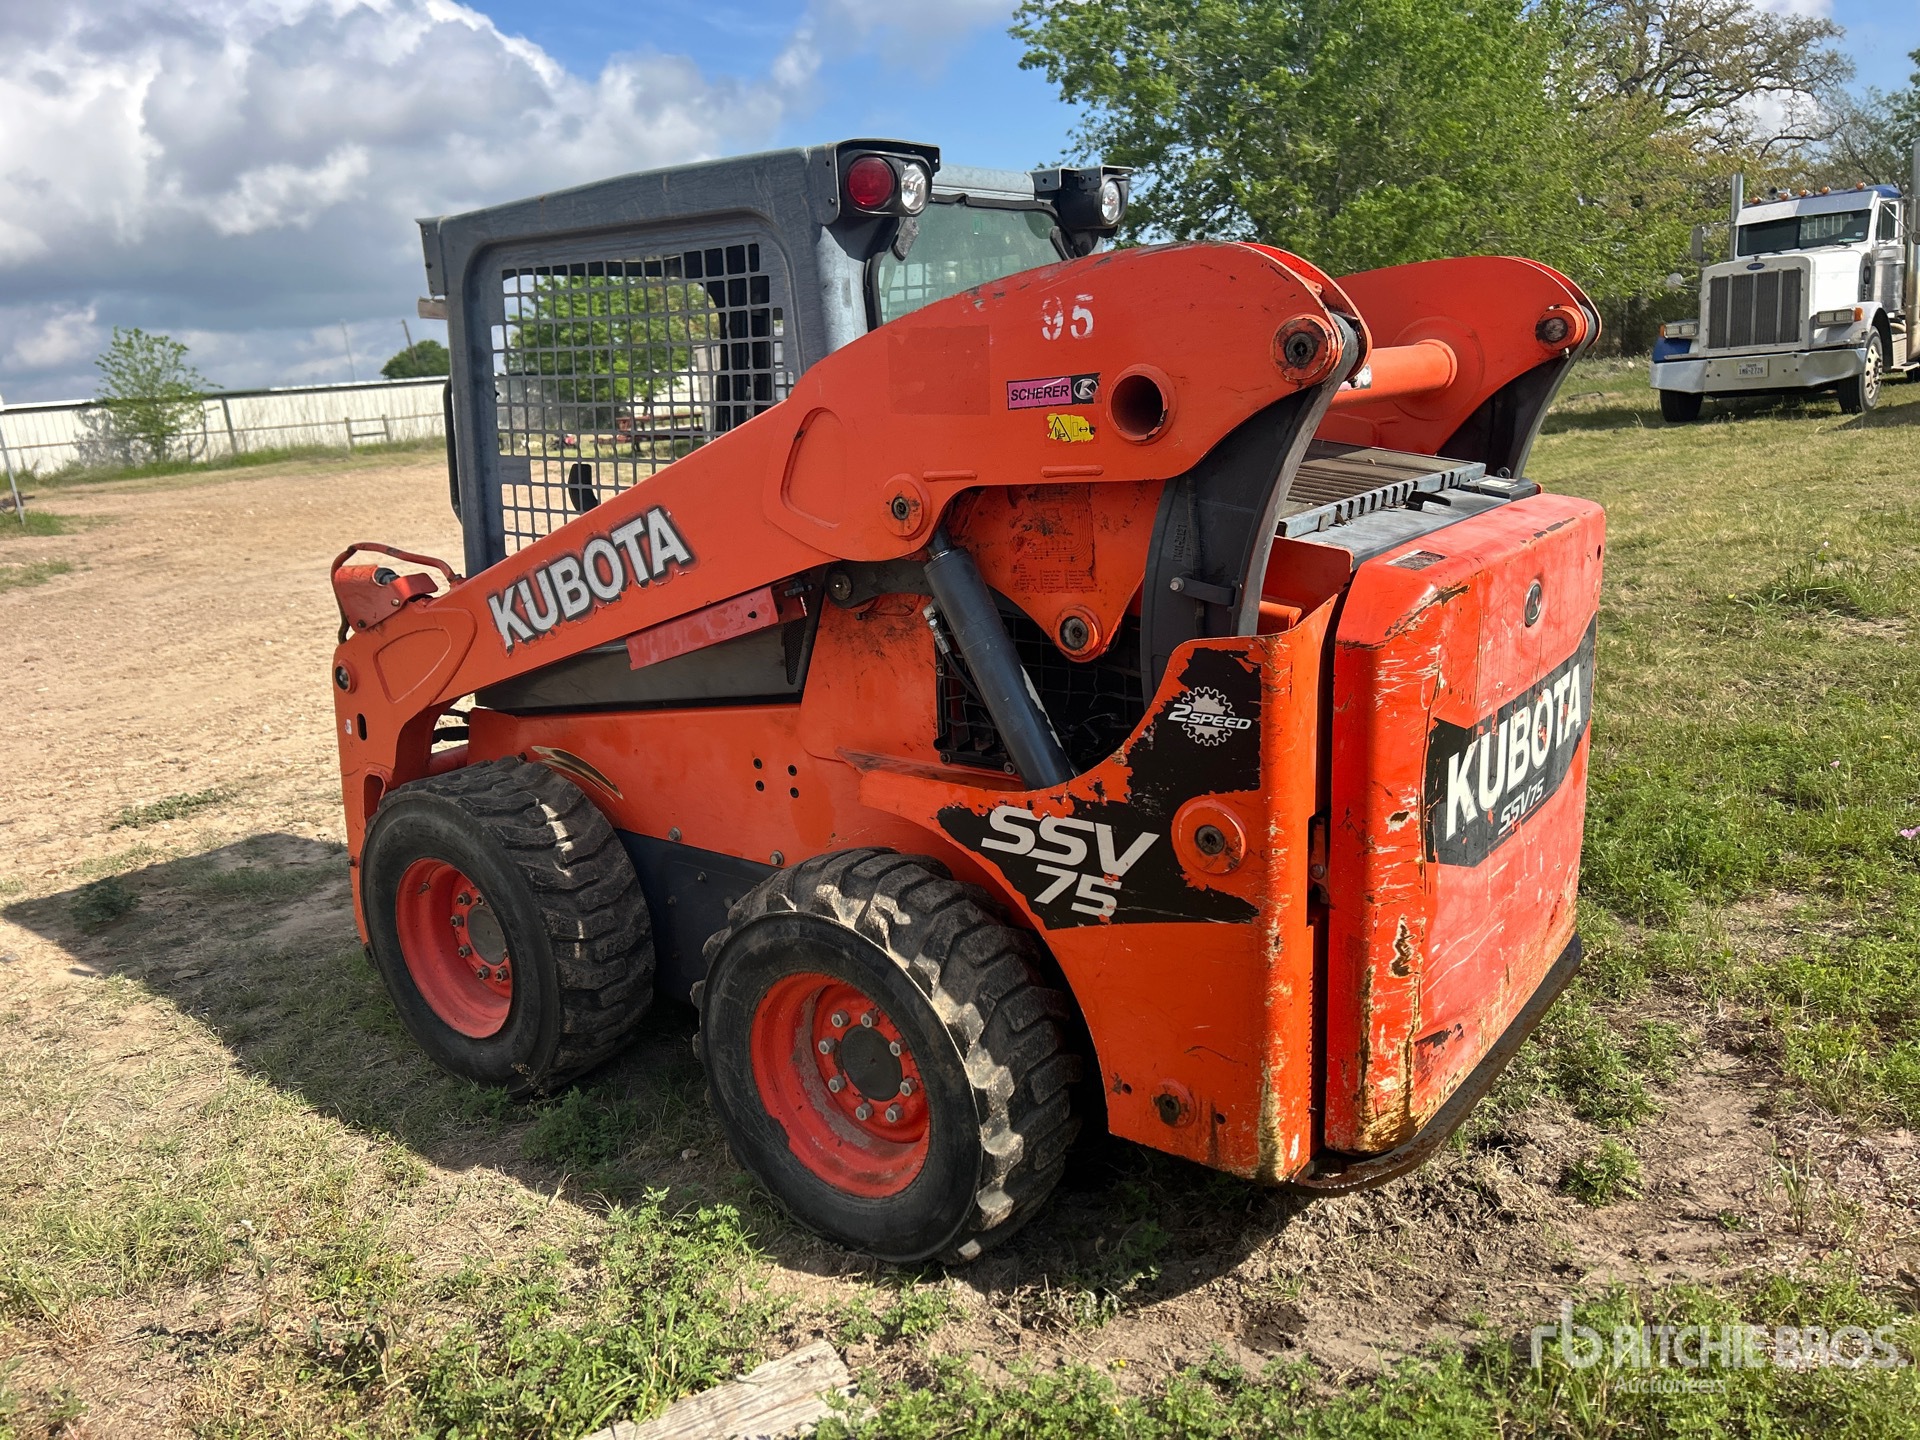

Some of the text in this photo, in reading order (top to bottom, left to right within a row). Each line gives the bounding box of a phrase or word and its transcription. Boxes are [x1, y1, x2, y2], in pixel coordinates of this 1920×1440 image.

[1041, 294, 1094, 341] 95
[1010, 385, 1069, 401] SCHERER
[488, 507, 694, 649] KUBOTA
[1445, 663, 1583, 842] KUBOTA
[1497, 777, 1545, 836] SSV75
[980, 805, 1160, 878] SSV
[1033, 864, 1122, 918] 75
